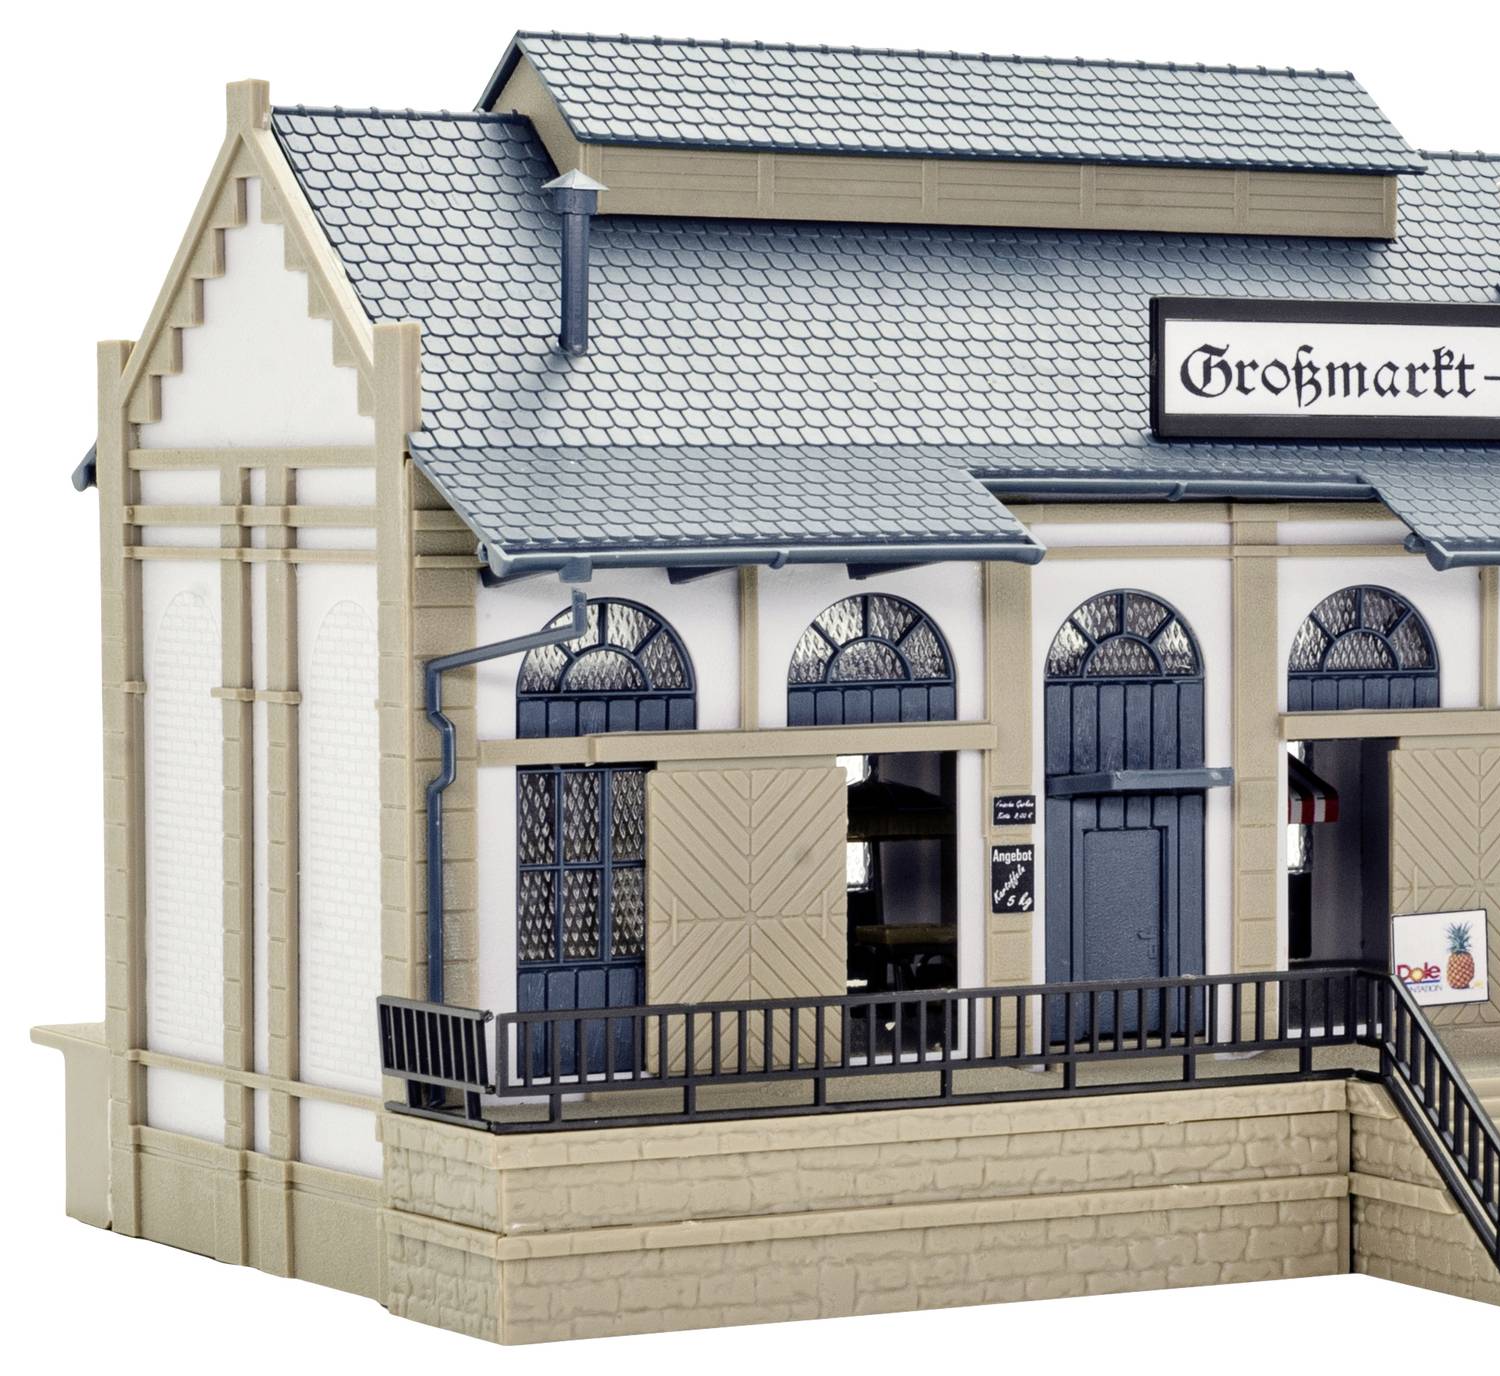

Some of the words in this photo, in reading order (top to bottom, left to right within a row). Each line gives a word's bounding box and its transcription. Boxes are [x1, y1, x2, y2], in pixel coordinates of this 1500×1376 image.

[1180, 343, 1476, 408] Großmarkt
[993, 848, 1032, 864] Angebot
[1007, 895, 1016, 906] 5
[1396, 961, 1441, 983] Dole
